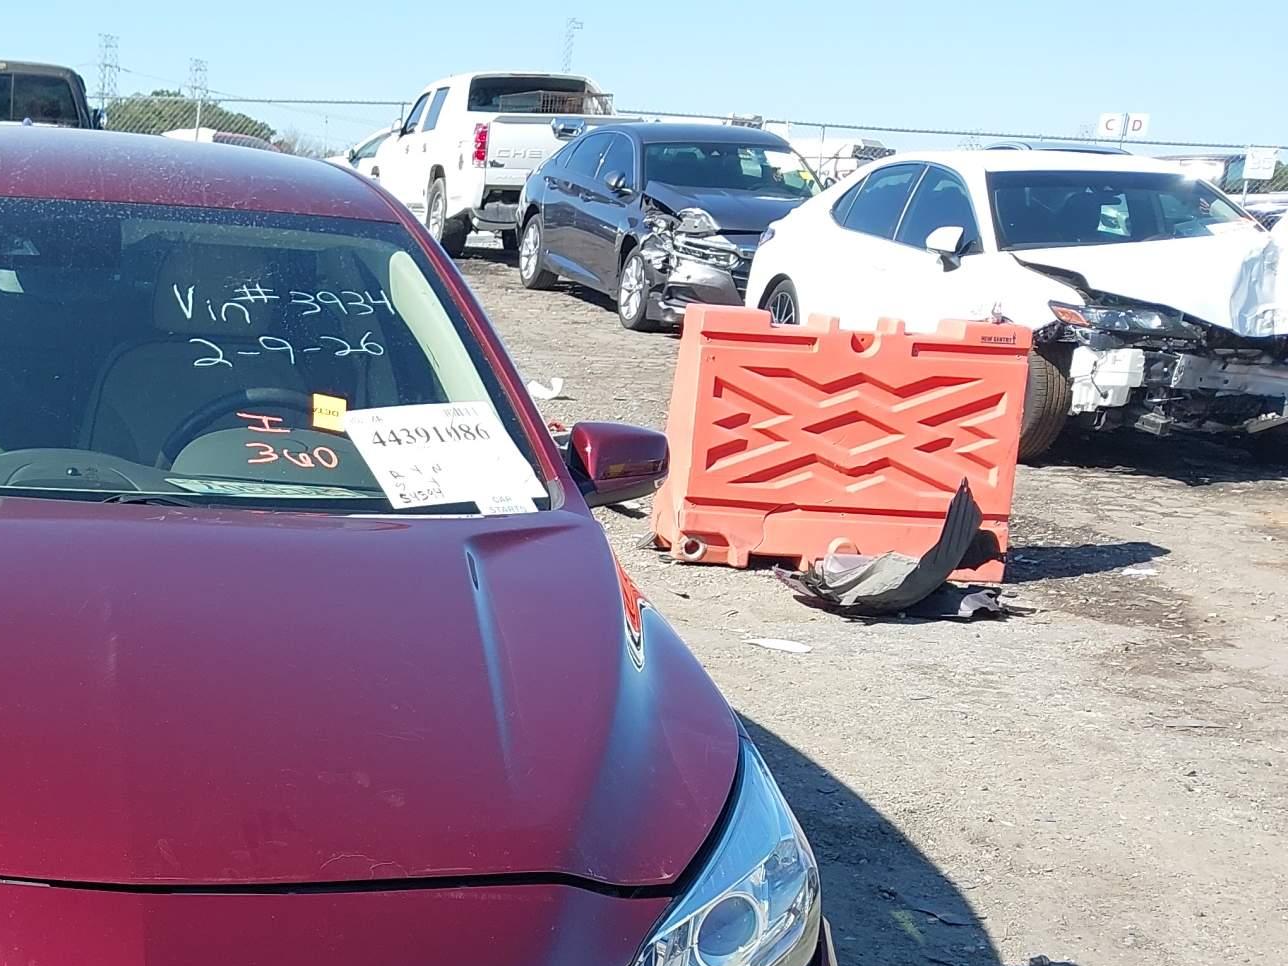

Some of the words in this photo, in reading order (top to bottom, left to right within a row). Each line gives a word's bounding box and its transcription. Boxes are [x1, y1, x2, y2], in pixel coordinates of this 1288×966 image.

[1104, 118, 1115, 131] C
[1131, 119, 1143, 132] D
[288, 289, 396, 316] 3934
[189, 331, 385, 368] 2-9-26
[371, 422, 491, 447] 44391086
[245, 442, 338, 469] 360
